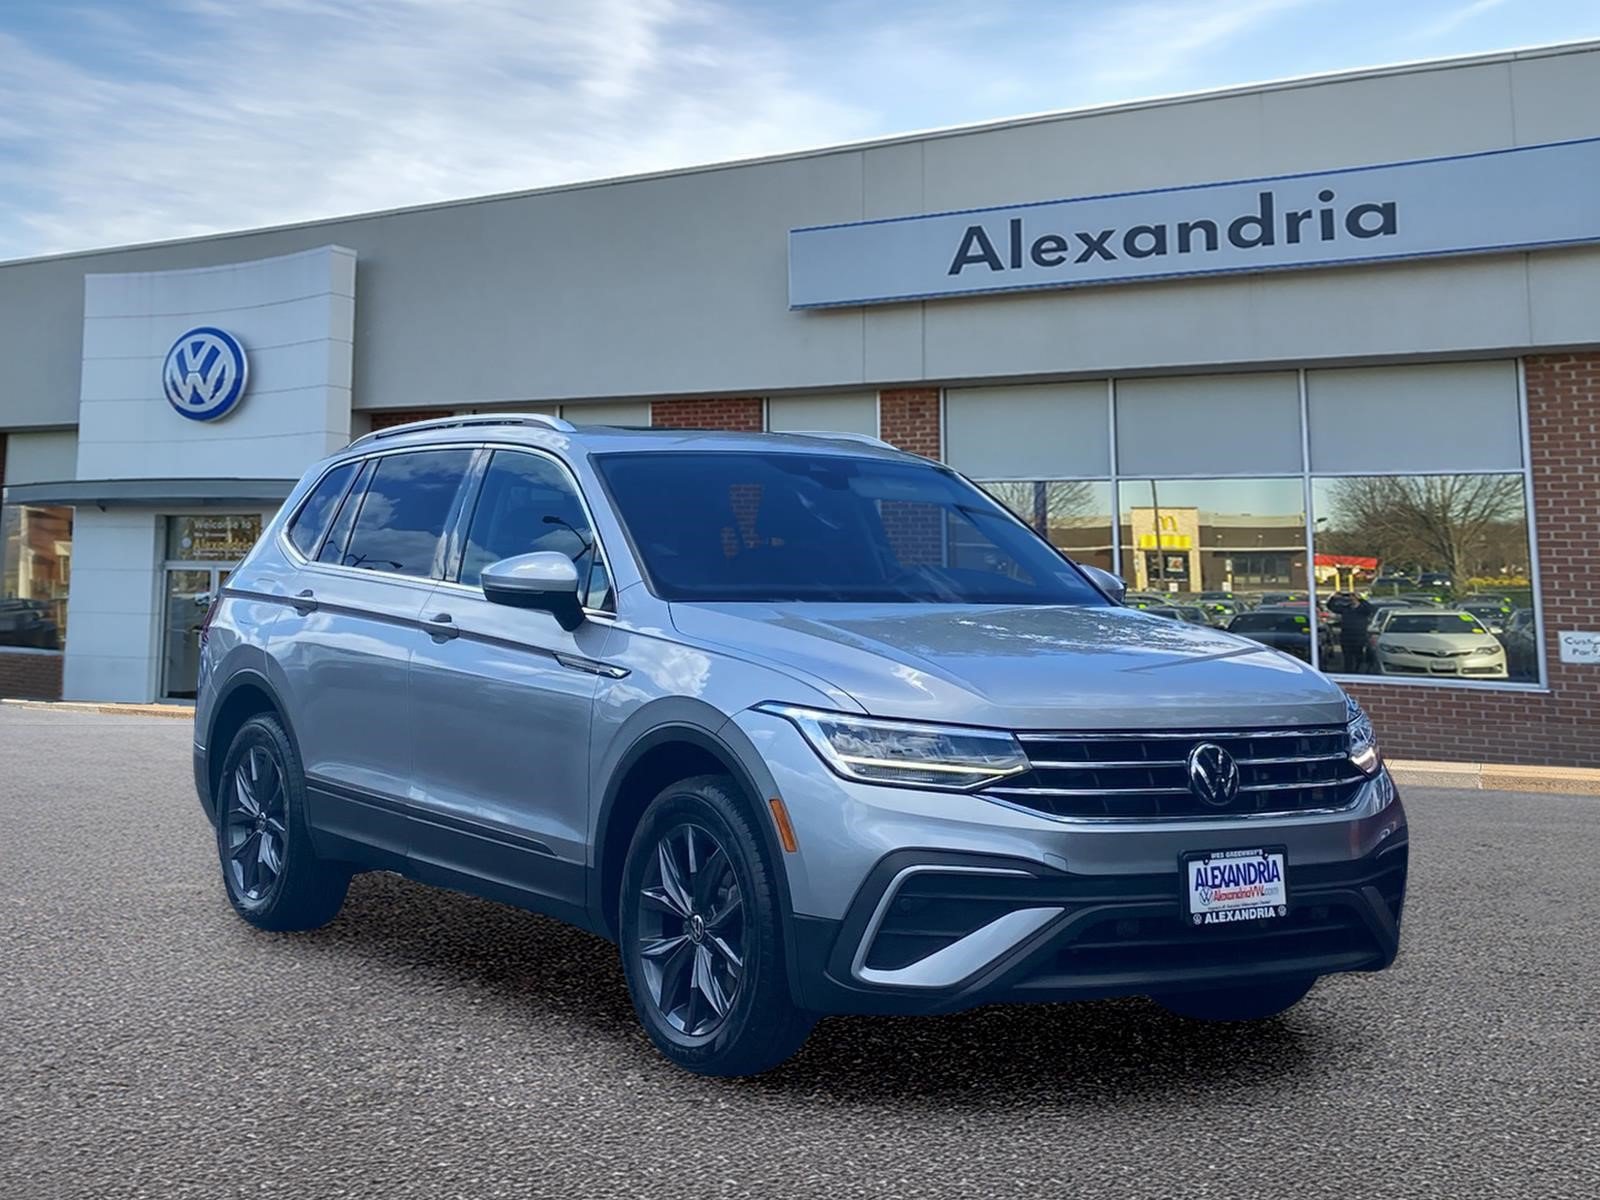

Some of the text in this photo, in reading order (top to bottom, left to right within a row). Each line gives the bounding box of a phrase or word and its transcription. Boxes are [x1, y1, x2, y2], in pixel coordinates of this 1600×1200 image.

[948, 189, 1398, 276] Alexandria
[164, 331, 239, 414] VW
[1195, 860, 1281, 891] ALEXANDRIA
[1204, 907, 1276, 924] ALEXANDRIA
